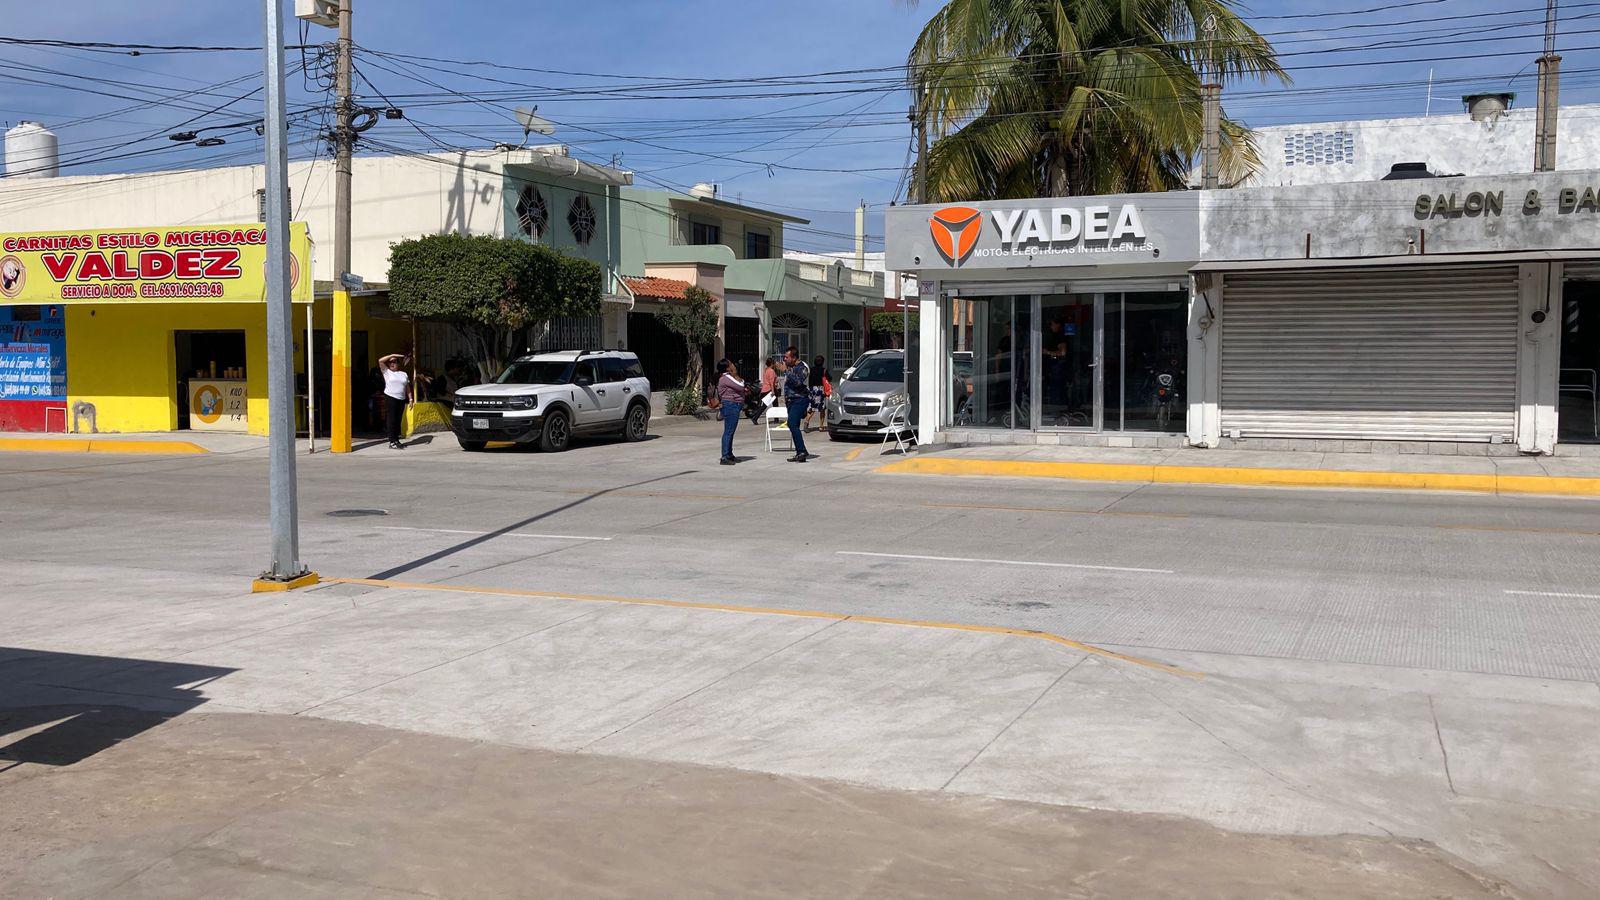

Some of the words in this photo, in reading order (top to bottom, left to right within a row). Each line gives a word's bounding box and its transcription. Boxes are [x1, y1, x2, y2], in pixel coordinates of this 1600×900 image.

[1414, 190, 1504, 218] SALON
[1522, 189, 1541, 214] &
[1557, 186, 1600, 214] BA
[991, 203, 1146, 246] YADEA
[3, 235, 93, 252] CARNITAS
[97, 231, 161, 249] ESTILO
[974, 247, 1009, 257] MOTOS
[1078, 242, 1153, 254] INTELIGENTES
[41, 248, 242, 281] VALDEZ
[61, 284, 101, 298] SERVICIO
[102, 284, 110, 297] A
[111, 283, 137, 298] DOM.
